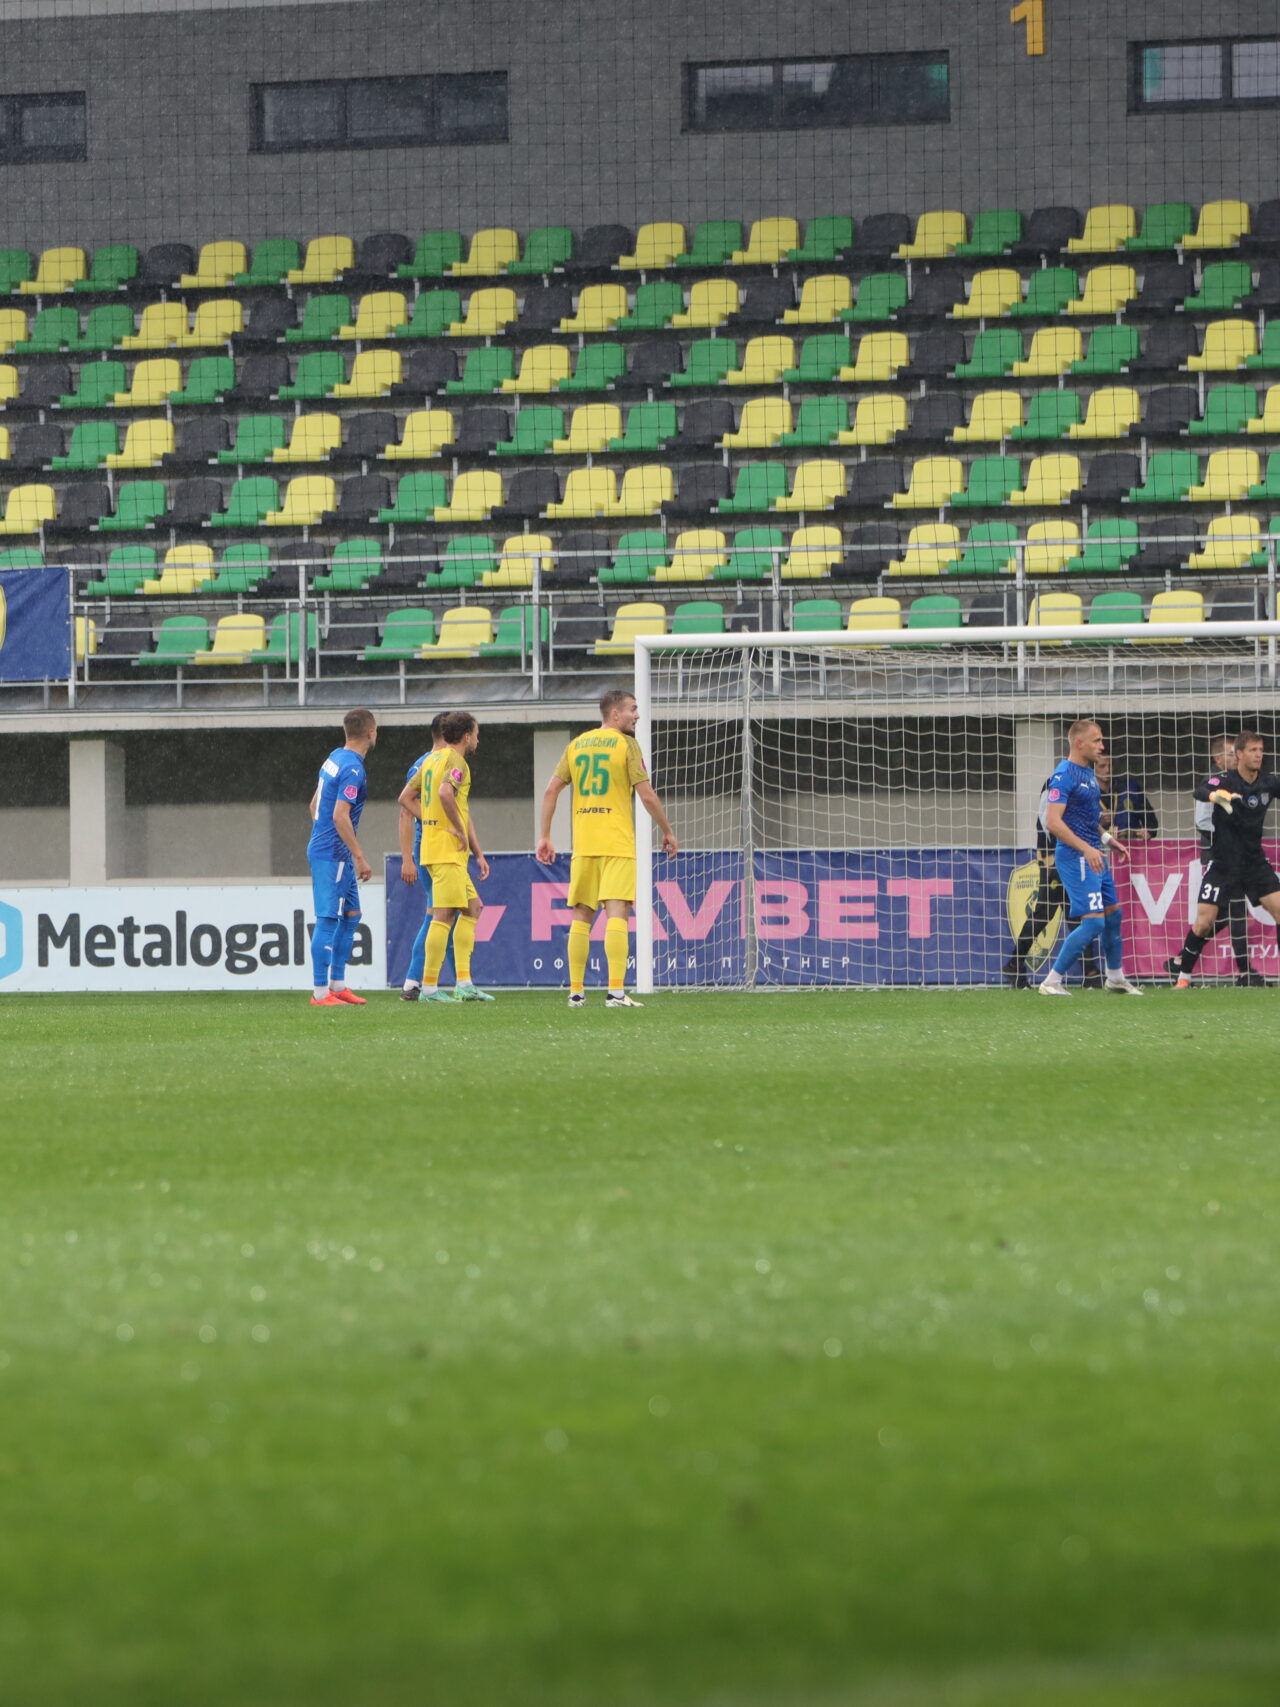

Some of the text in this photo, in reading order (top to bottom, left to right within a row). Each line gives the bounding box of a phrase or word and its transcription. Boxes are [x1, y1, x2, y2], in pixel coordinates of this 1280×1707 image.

[1010, 0, 1044, 56] 1
[575, 753, 610, 796] 25
[1201, 883, 1220, 902] 31
[37, 909, 373, 974] Metalogala
